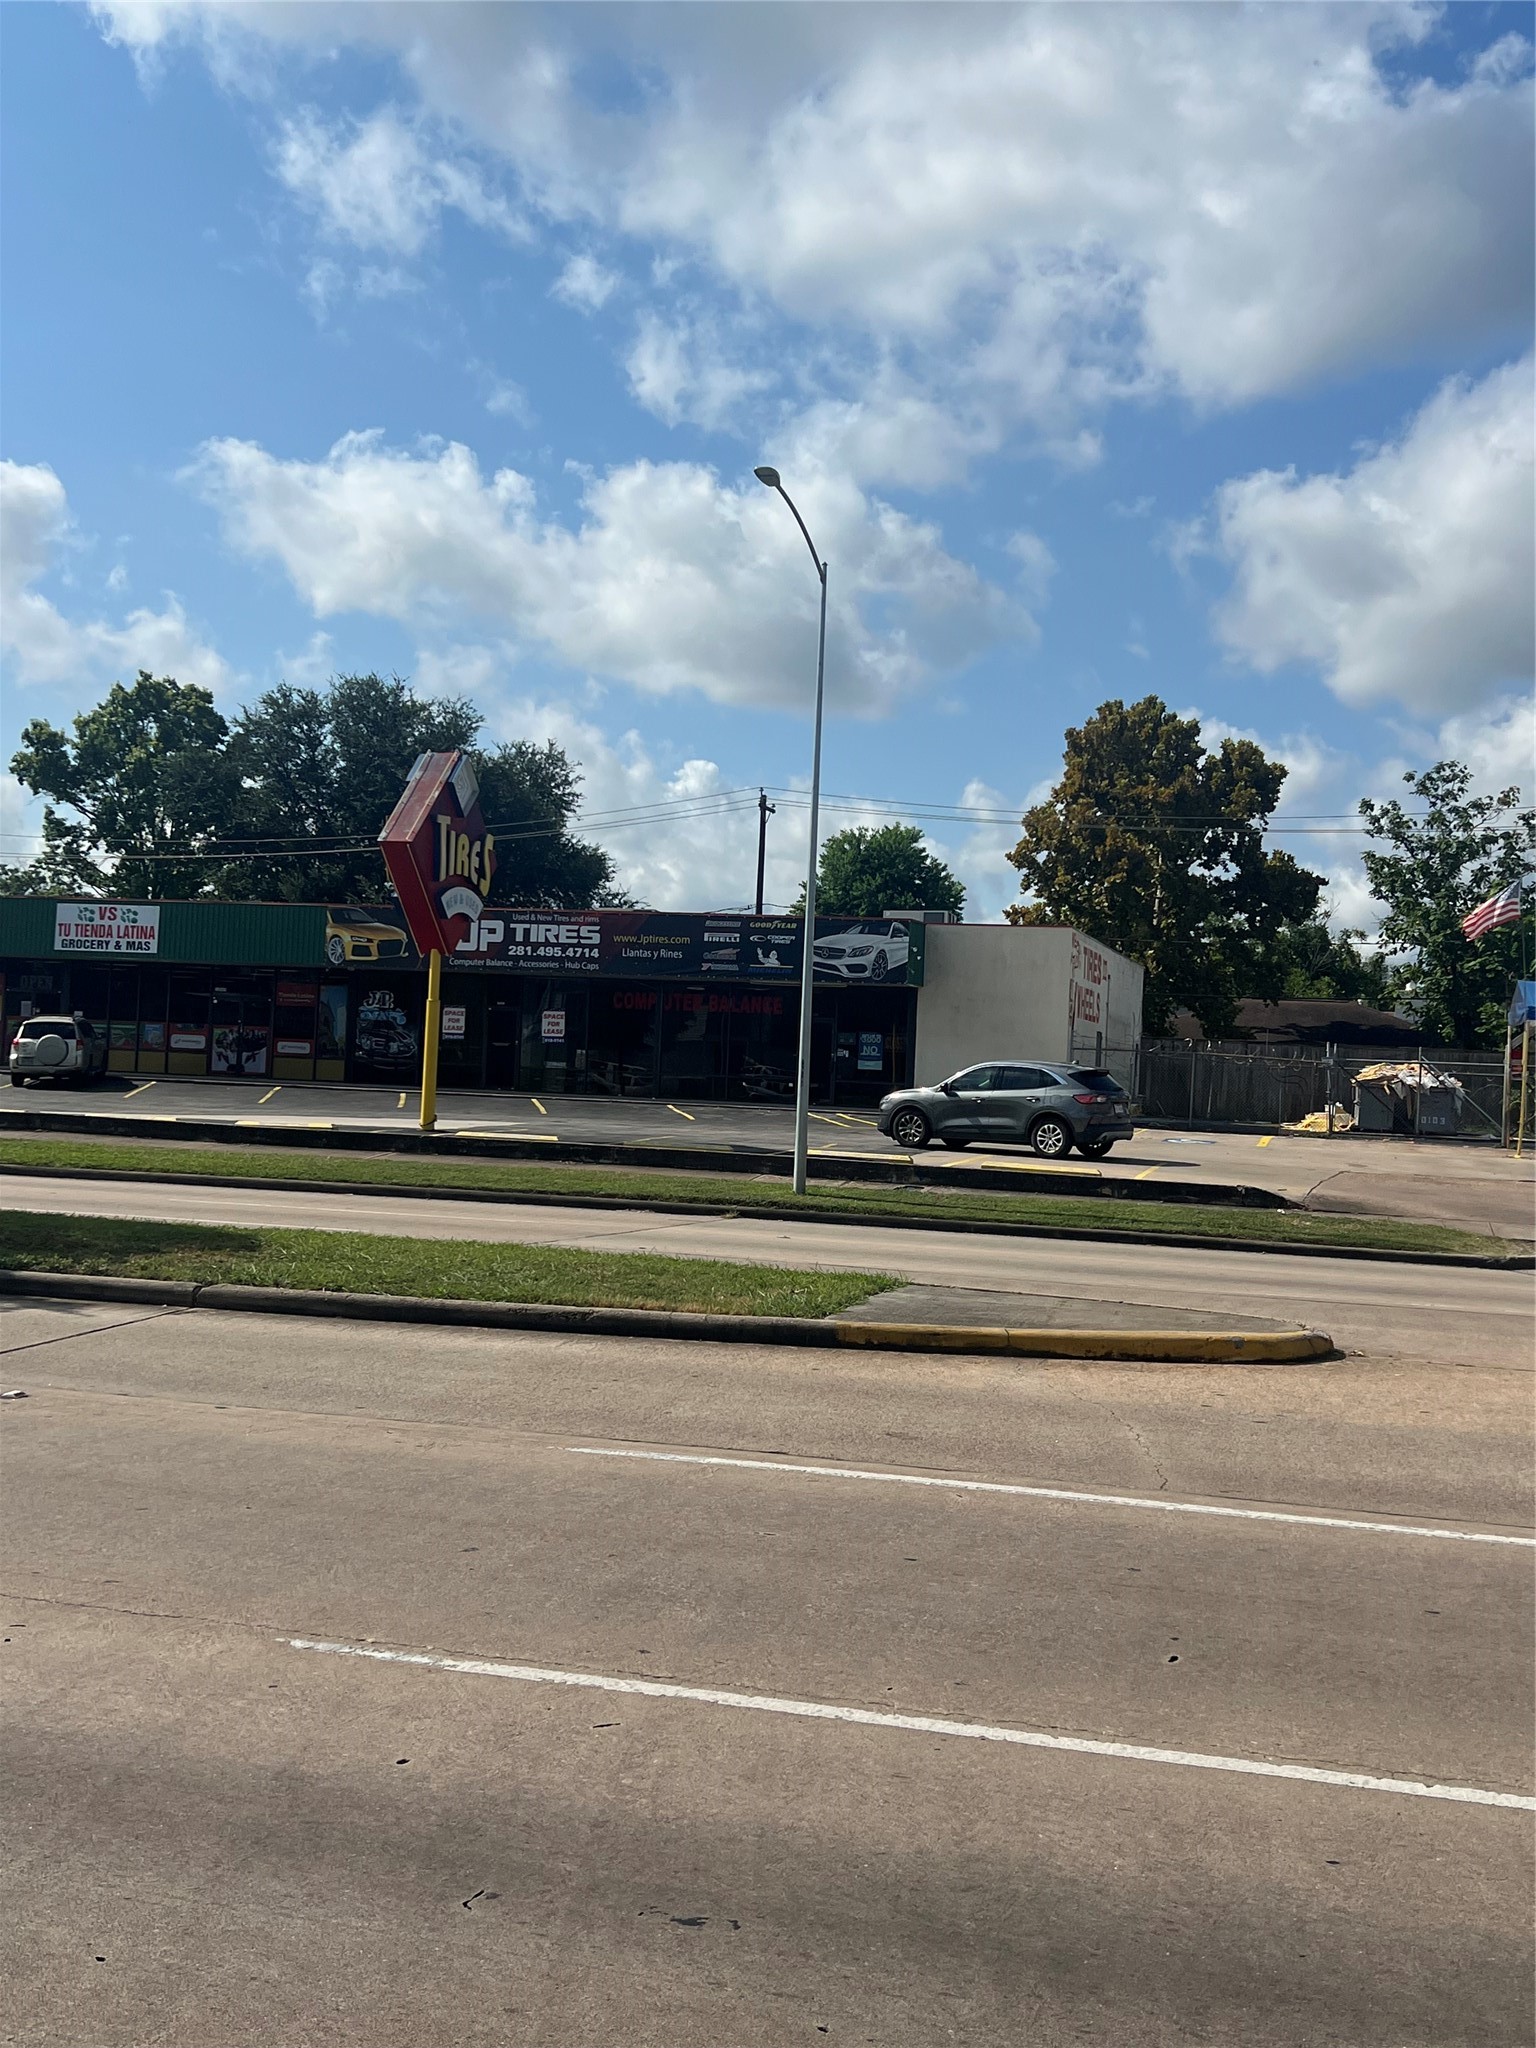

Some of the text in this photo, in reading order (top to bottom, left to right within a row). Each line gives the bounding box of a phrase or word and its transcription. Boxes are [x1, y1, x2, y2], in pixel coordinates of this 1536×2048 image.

[437, 814, 495, 897] TIRES
[98, 906, 118, 921] VS
[512, 913, 529, 921] Used
[554, 914, 569, 922] Tires
[570, 915, 583, 923] and
[584, 915, 599, 923] rims
[58, 923, 156, 940] TU TIENDA LATINA
[749, 920, 797, 930] GOODYEAR
[455, 920, 601, 951] JP TIRES
[704, 932, 740, 942] PIRELLI
[61, 938, 151, 951] GROCERY & MAS
[508, 945, 599, 958] 281.495.4714
[622, 947, 683, 960] Llantas y Rines
[449, 957, 485, 967] Computer
[486, 958, 513, 967] Balance
[519, 959, 559, 968] Accessories
[565, 960, 581, 969] Hub
[581, 961, 599, 971] Caps
[708, 994, 783, 1015] BALANCE
[1420, 1116, 1446, 1125] 0103
